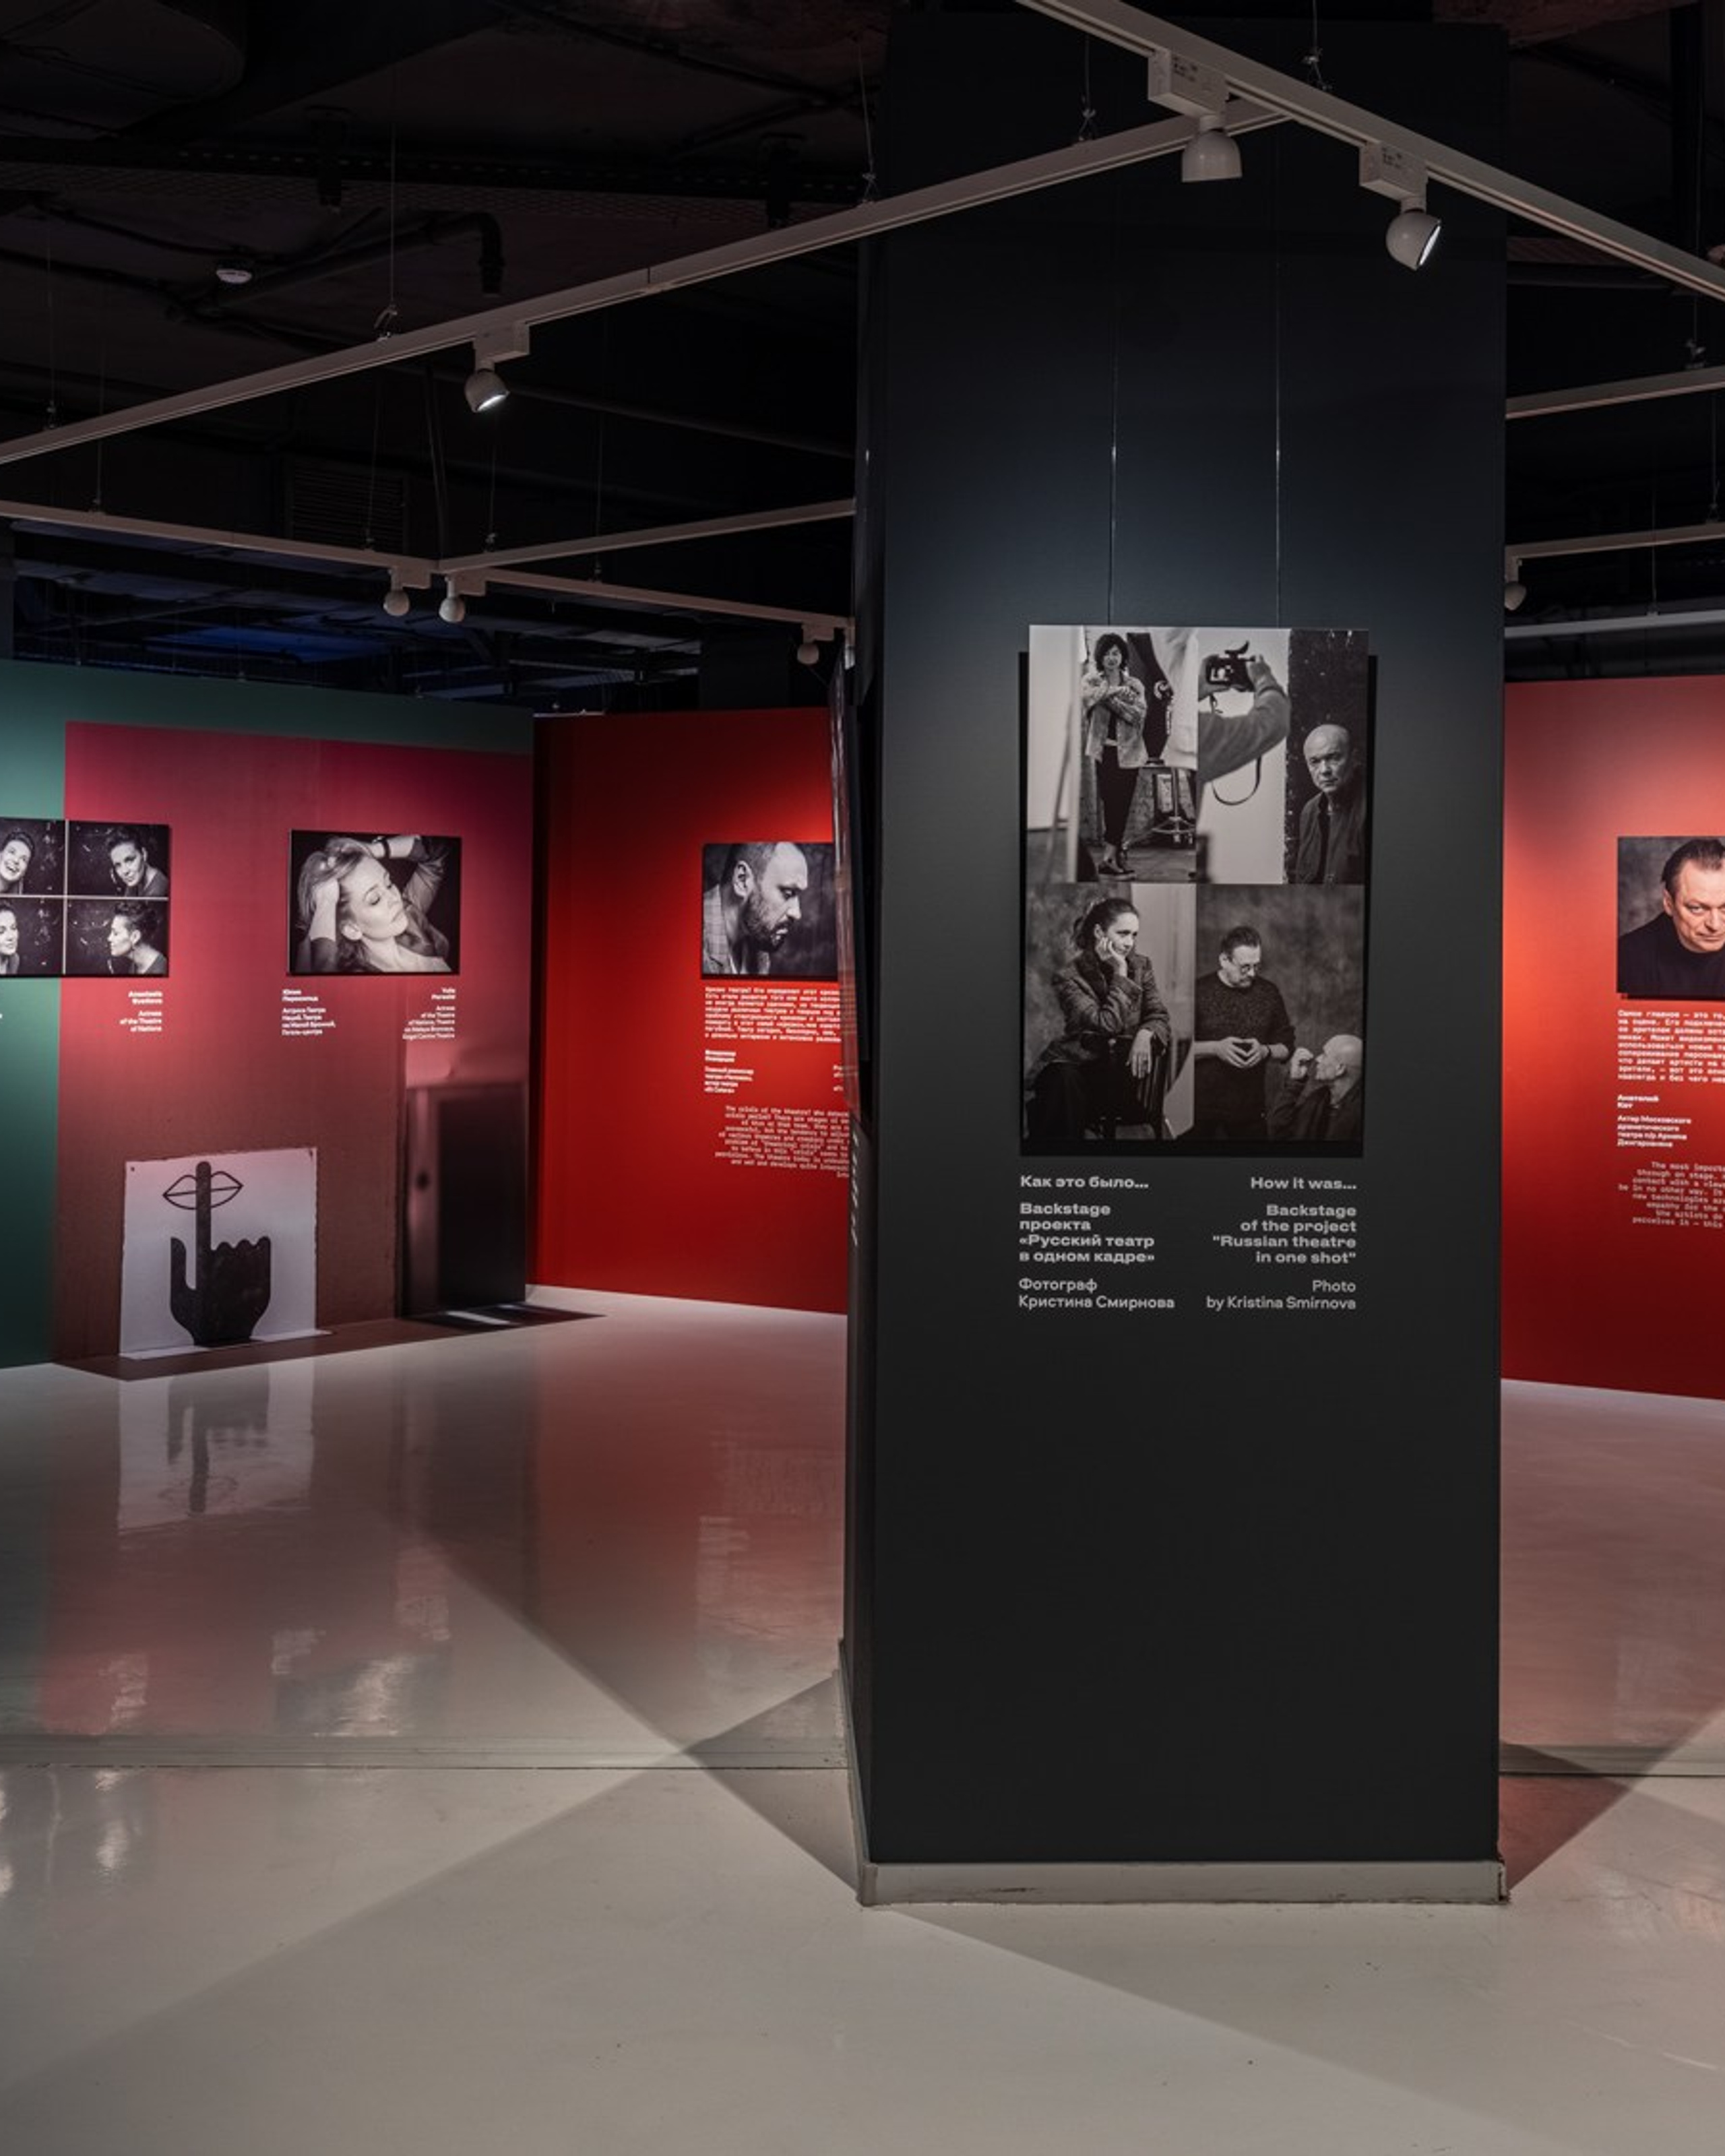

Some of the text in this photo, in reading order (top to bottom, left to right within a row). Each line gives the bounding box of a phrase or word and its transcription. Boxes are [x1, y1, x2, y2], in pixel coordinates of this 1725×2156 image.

[1020, 1175, 1149, 1189] Как это было...
[1251, 1177, 1357, 1189] How it was...
[1020, 1203, 1110, 1217] Backstage
[1267, 1204, 1356, 1219] Backstage
[1020, 1221, 1091, 1232] проекта
[1240, 1220, 1356, 1234] of the project
[1020, 1234, 1154, 1248] «Русский театр
[1213, 1235, 1356, 1248] "Russian theatre
[1020, 1253, 1154, 1265] в одном кадре»
[1256, 1251, 1356, 1264] in one shot"
[1019, 1277, 1098, 1294] Фотограф
[1313, 1279, 1356, 1292] Photo
[1019, 1295, 1175, 1311] Кристина Смирнова
[1206, 1296, 1356, 1311] by Kristina Smirnova
